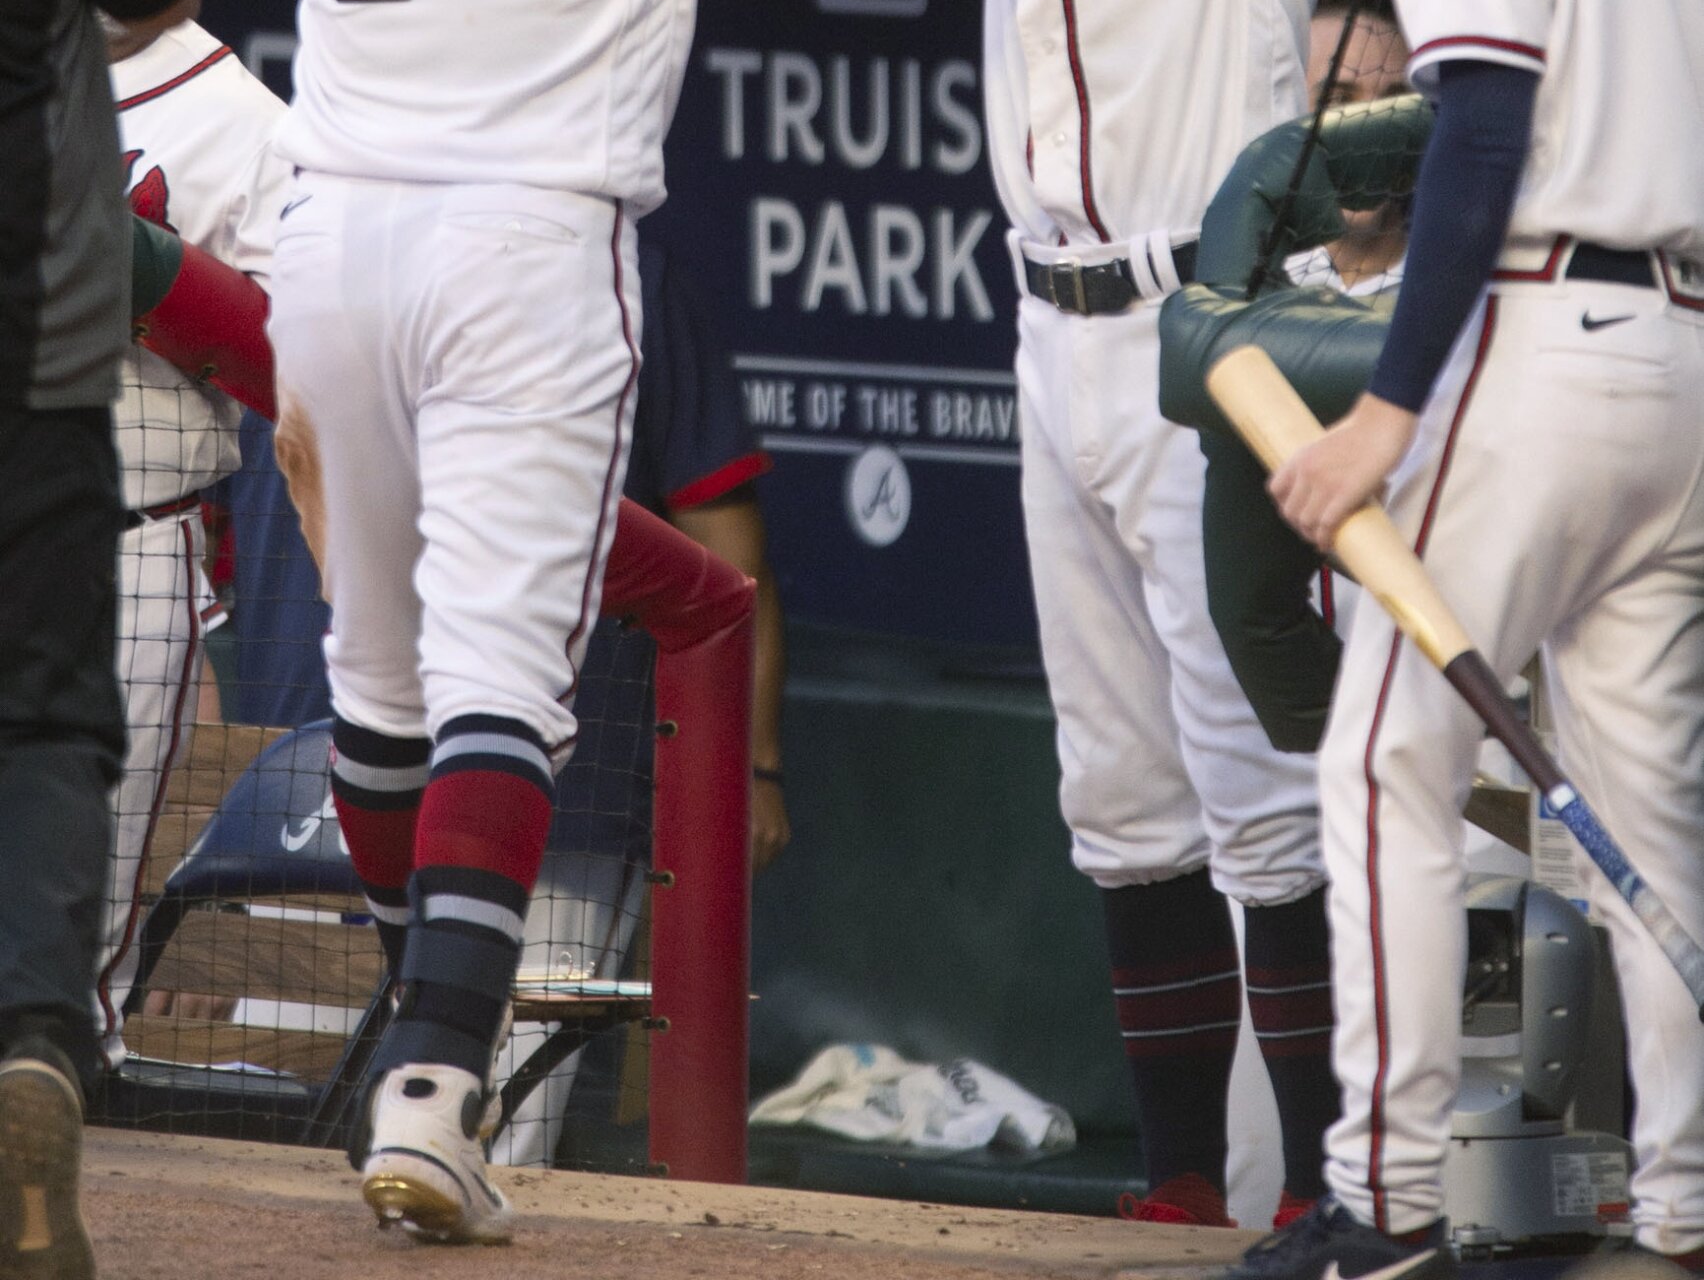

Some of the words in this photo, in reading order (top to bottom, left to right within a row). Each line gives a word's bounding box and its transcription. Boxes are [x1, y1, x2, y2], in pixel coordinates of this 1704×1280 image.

[706, 49, 984, 175] TRUIS
[750, 197, 997, 323] PARK
[744, 381, 797, 426] ME
[809, 383, 848, 429] OF
[857, 387, 919, 435] THE
[931, 393, 1021, 441] BRAV
